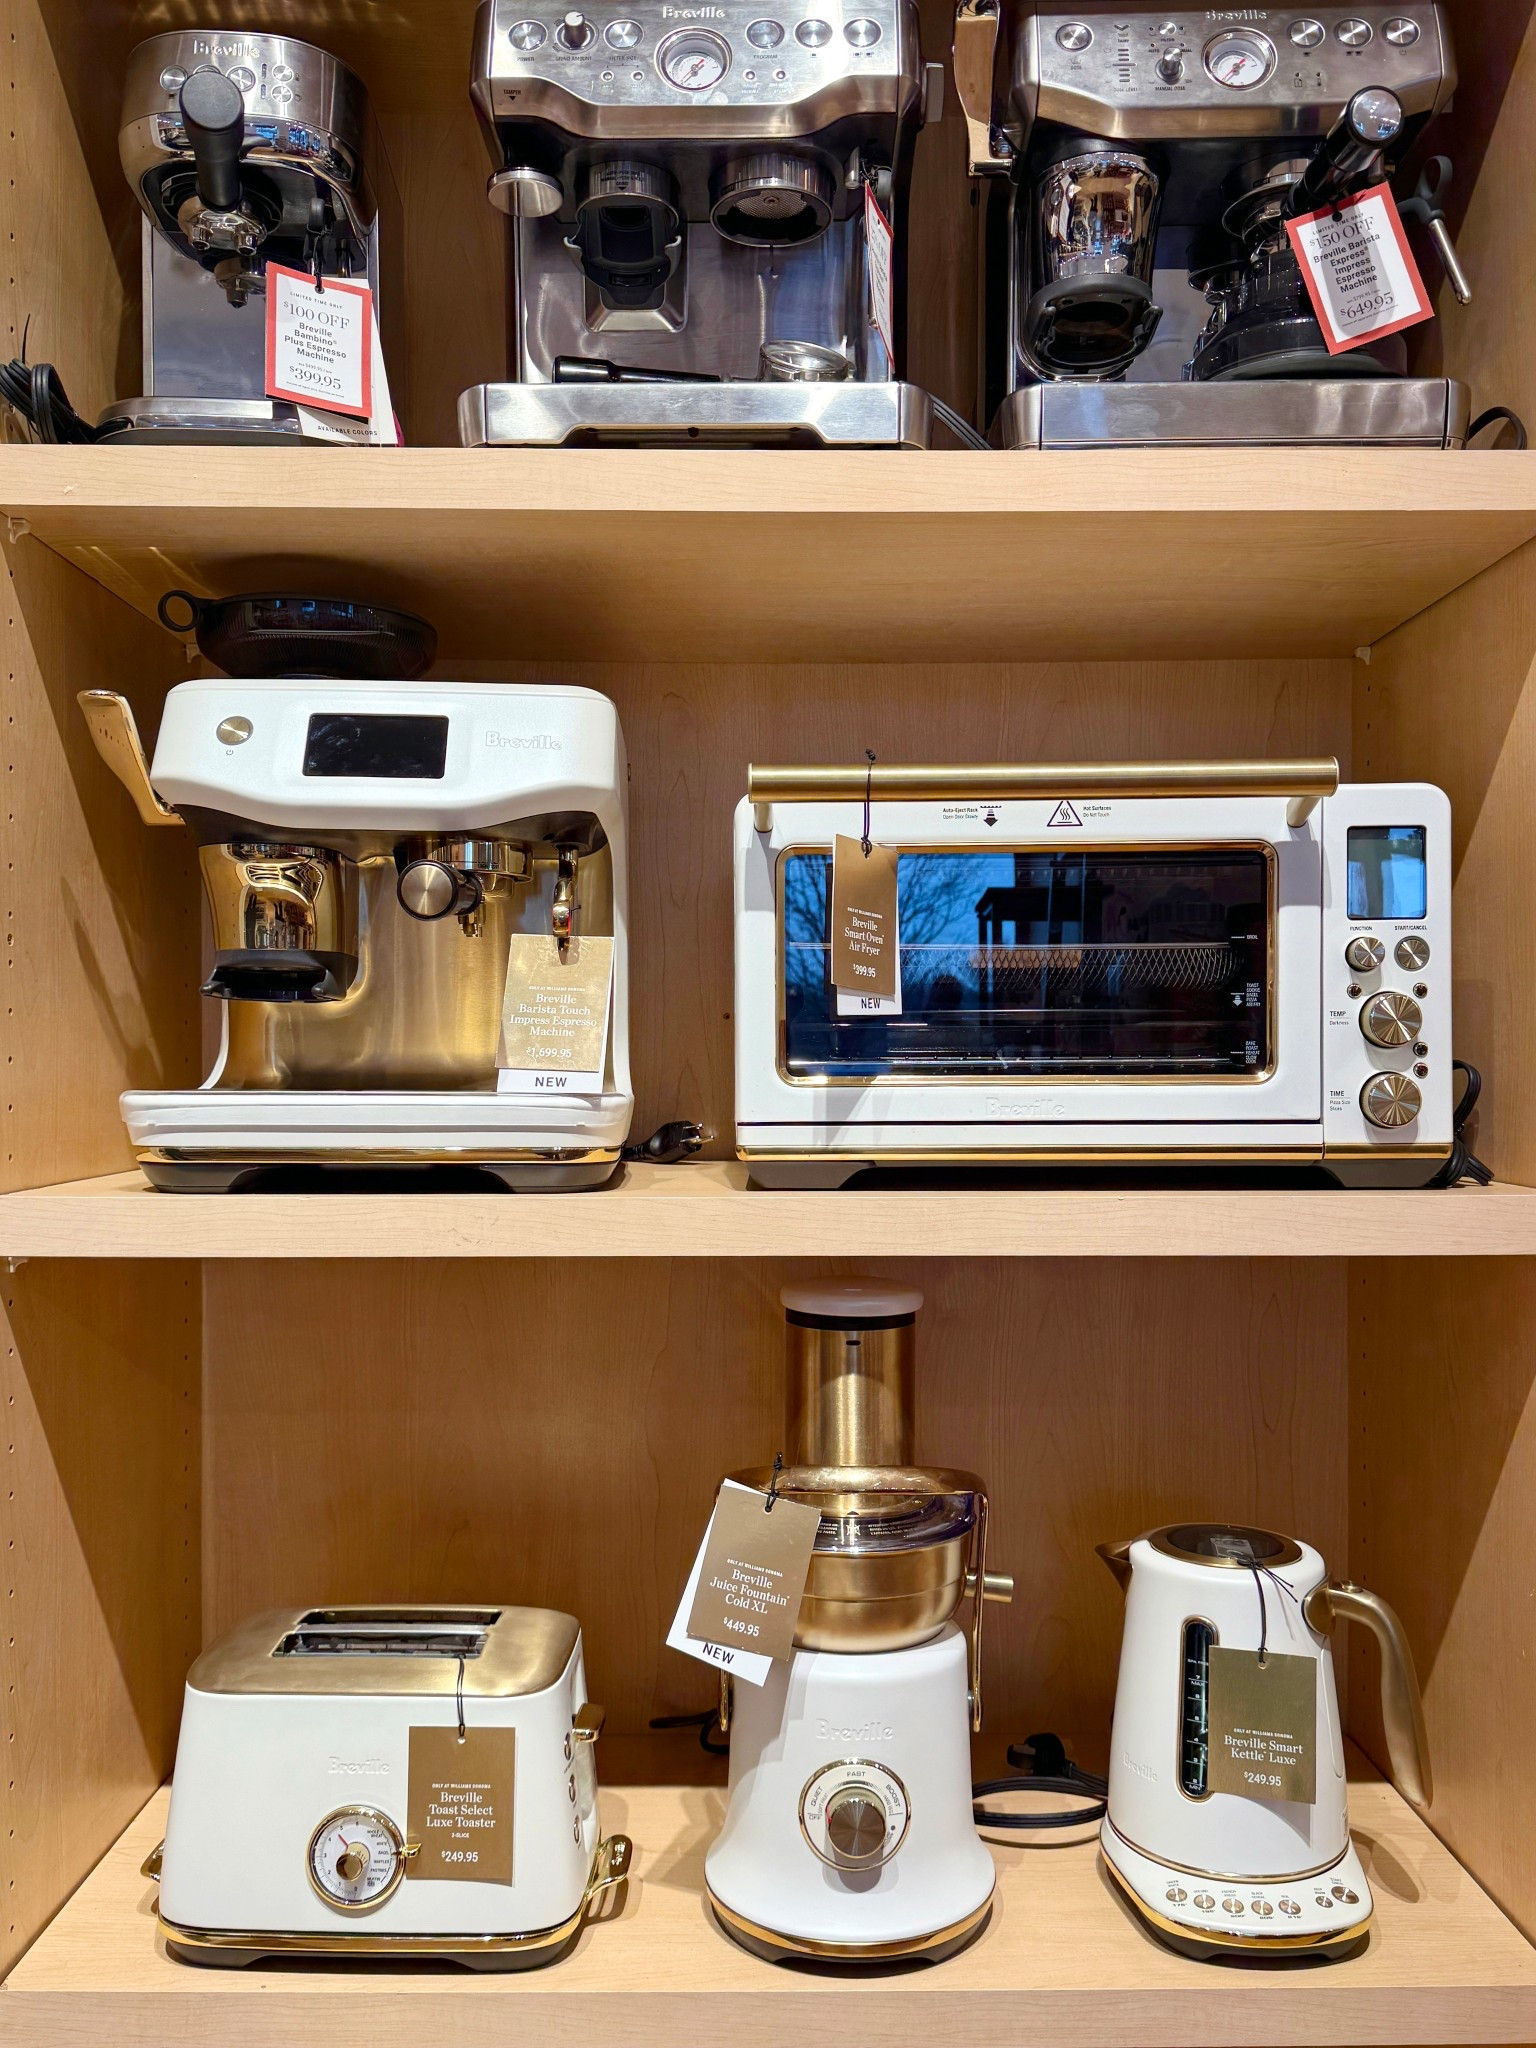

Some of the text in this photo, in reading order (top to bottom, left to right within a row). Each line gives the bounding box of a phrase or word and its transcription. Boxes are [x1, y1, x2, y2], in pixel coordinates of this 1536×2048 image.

[662, 6, 726, 18] Breville
[1205, 10, 1267, 20] Breville
[194, 39, 260, 58] Breville
[1310, 217, 1374, 250] $150 OFF
[1314, 233, 1380, 263] Breville Barista
[1335, 257, 1370, 275] Impress
[1336, 266, 1376, 285] Espresso
[1340, 274, 1378, 293] Machine
[290, 292, 312, 302] LIMITED
[314, 298, 327, 306] TIME
[1340, 292, 1394, 319] $649.95
[284, 301, 350, 329] $100 OFF
[300, 322, 333, 338] Breville
[284, 335, 347, 359] Plus Espresso
[297, 347, 334, 364] Machine
[290, 365, 341, 390] $399.95
[317, 425, 350, 434] AVAILABLE
[485, 730, 563, 750] Breville
[852, 916, 878, 931] Breville
[844, 927, 865, 939] Smart
[849, 940, 880, 956] Air Fryer
[853, 963, 876, 978] $399.95
[536, 994, 576, 1004] Breville
[861, 998, 880, 1009] NEW
[518, 1004, 591, 1015] Barista Touch
[509, 1015, 597, 1028] Impress Espresso
[530, 1026, 575, 1037] Machine
[527, 1047, 572, 1058] $1,699.95
[535, 1077, 567, 1087] NEW
[986, 1097, 1064, 1118] Breville
[744, 1562, 765, 1572] WILLIAMS
[710, 1576, 738, 1592] Juice
[732, 1569, 773, 1589] Breville
[725, 1594, 768, 1614] Cold XL
[723, 1616, 760, 1637] $449.95
[702, 1642, 735, 1665] NEW
[816, 1718, 894, 1741] Breville
[1224, 1735, 1304, 1754] Breville Smart
[328, 1756, 390, 1775] Breville
[1269, 1752, 1296, 1765] Luxe
[1244, 1771, 1282, 1787] $249.95
[440, 1792, 482, 1803] Breville
[811, 1786, 823, 1806] QUIET
[885, 1784, 901, 1807] BOOST
[429, 1804, 493, 1815] Toast Select
[426, 1816, 496, 1828] Luxe Toaster
[442, 1851, 478, 1862] $249.95
